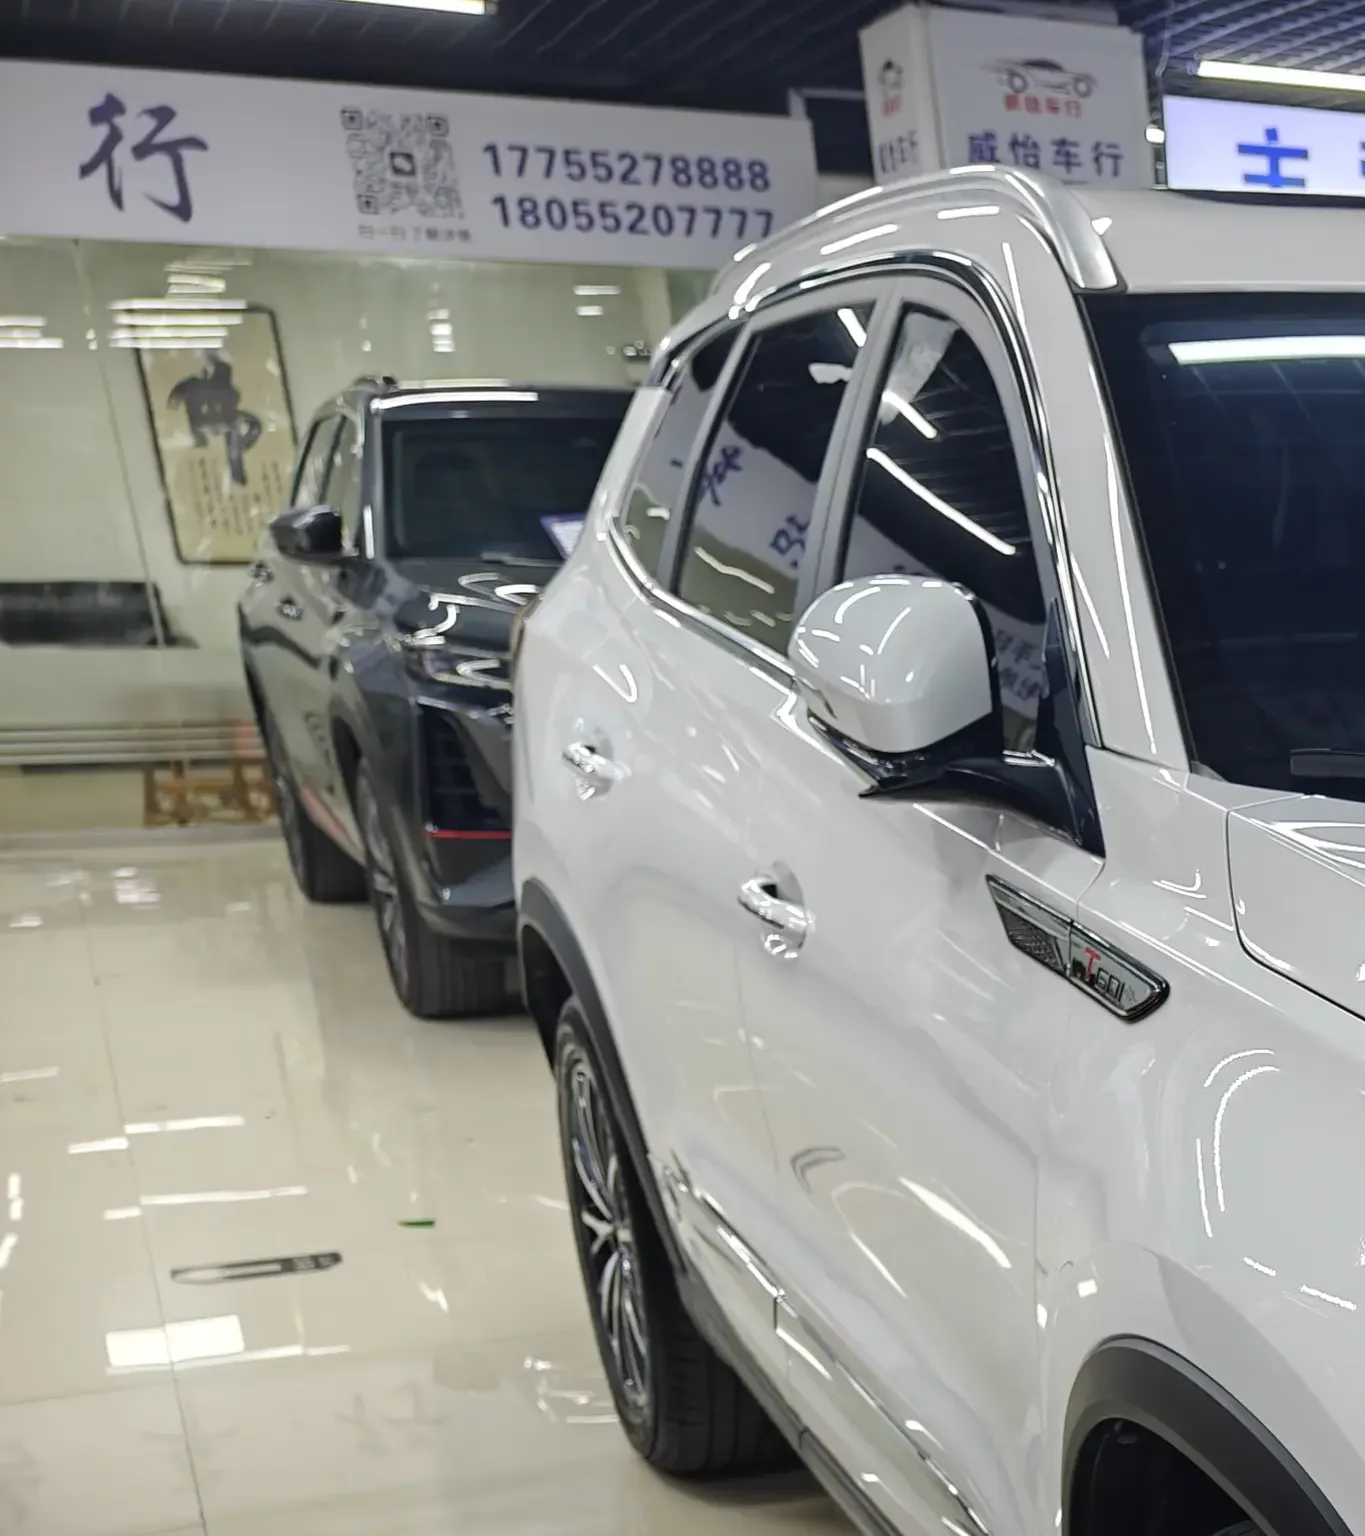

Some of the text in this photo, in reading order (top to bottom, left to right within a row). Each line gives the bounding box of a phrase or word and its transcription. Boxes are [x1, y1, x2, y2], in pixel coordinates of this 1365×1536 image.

[79, 91, 209, 223] 行
[482, 142, 772, 193] 17755278888
[968, 130, 1124, 178] 威怡车行
[491, 194, 774, 240] 18055207777
